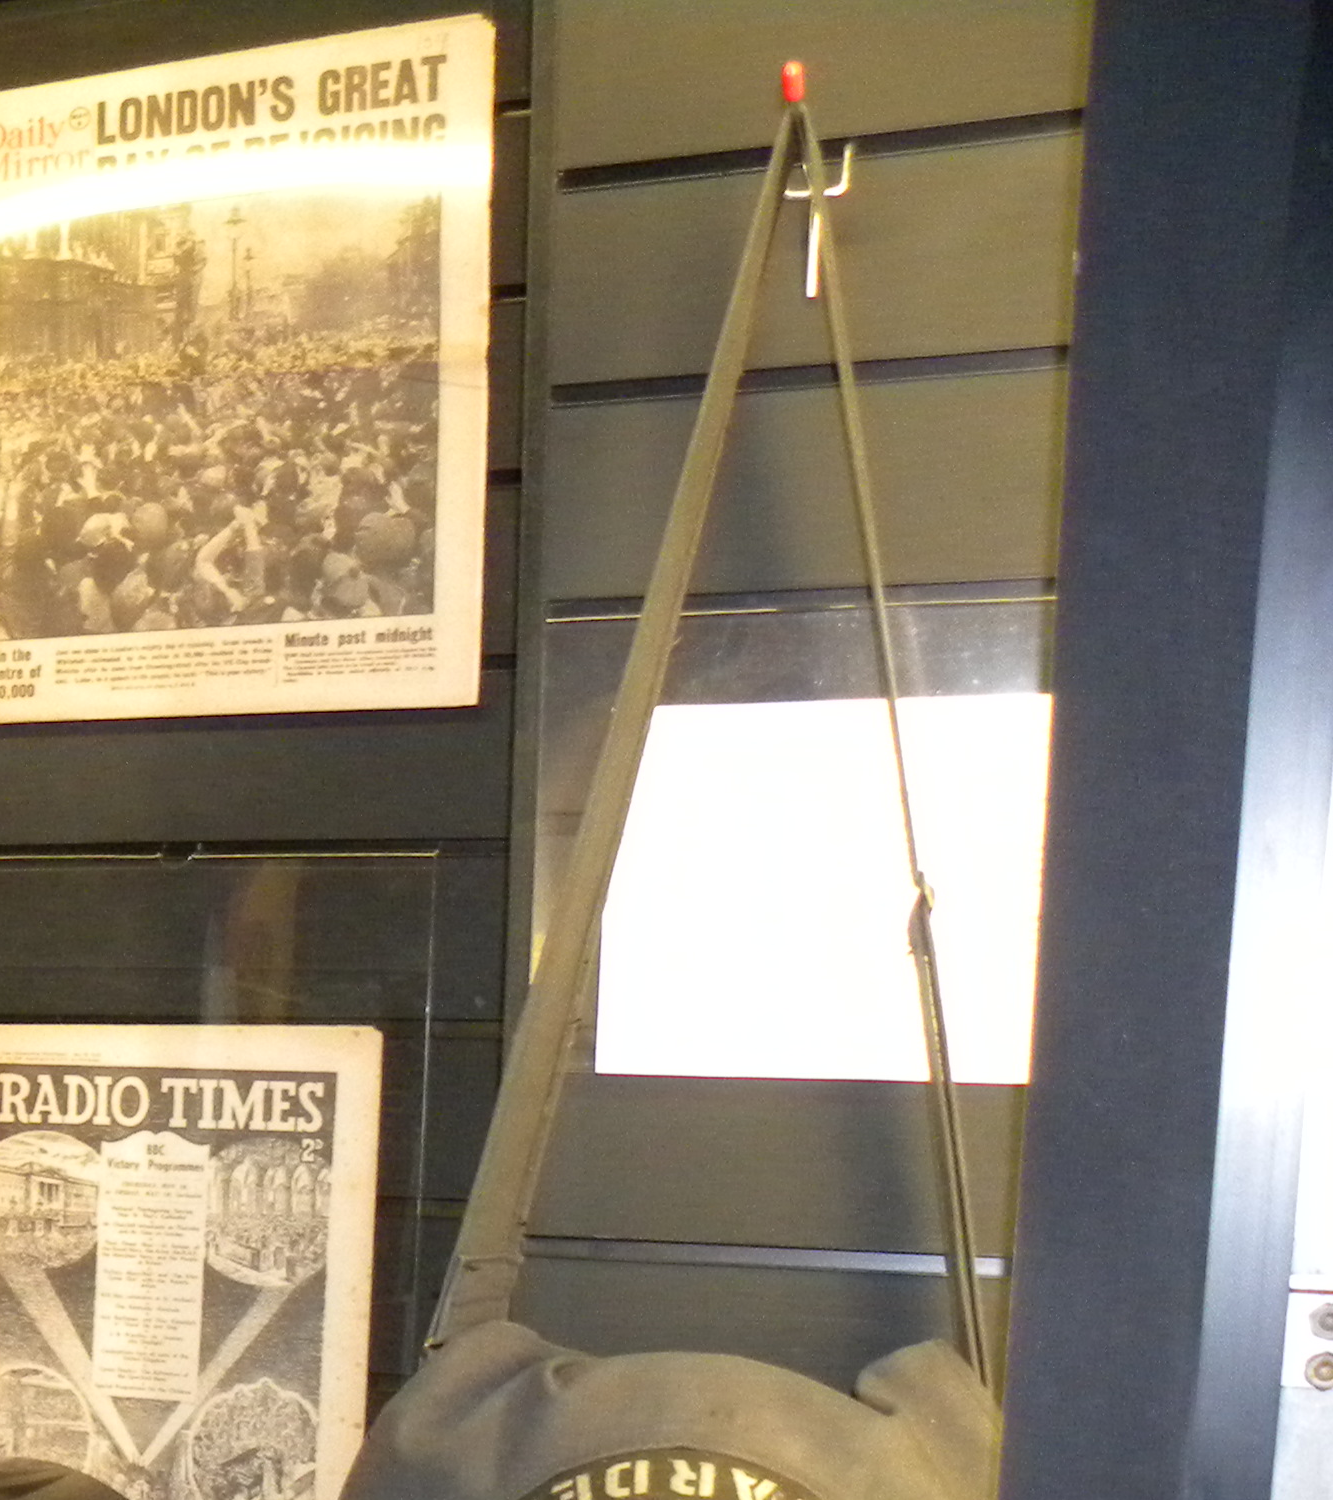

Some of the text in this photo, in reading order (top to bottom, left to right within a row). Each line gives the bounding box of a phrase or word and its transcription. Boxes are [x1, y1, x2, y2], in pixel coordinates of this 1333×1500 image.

[97, 76, 295, 145] LONDON'S
[318, 55, 447, 117] GREAT
[285, 627, 433, 648] Minute past midnight
[12, 649, 31, 662] the
[29, 666, 41, 678] of
[161, 1077, 325, 1133] TIMES
[107, 1158, 204, 1172] Victory Programmes
